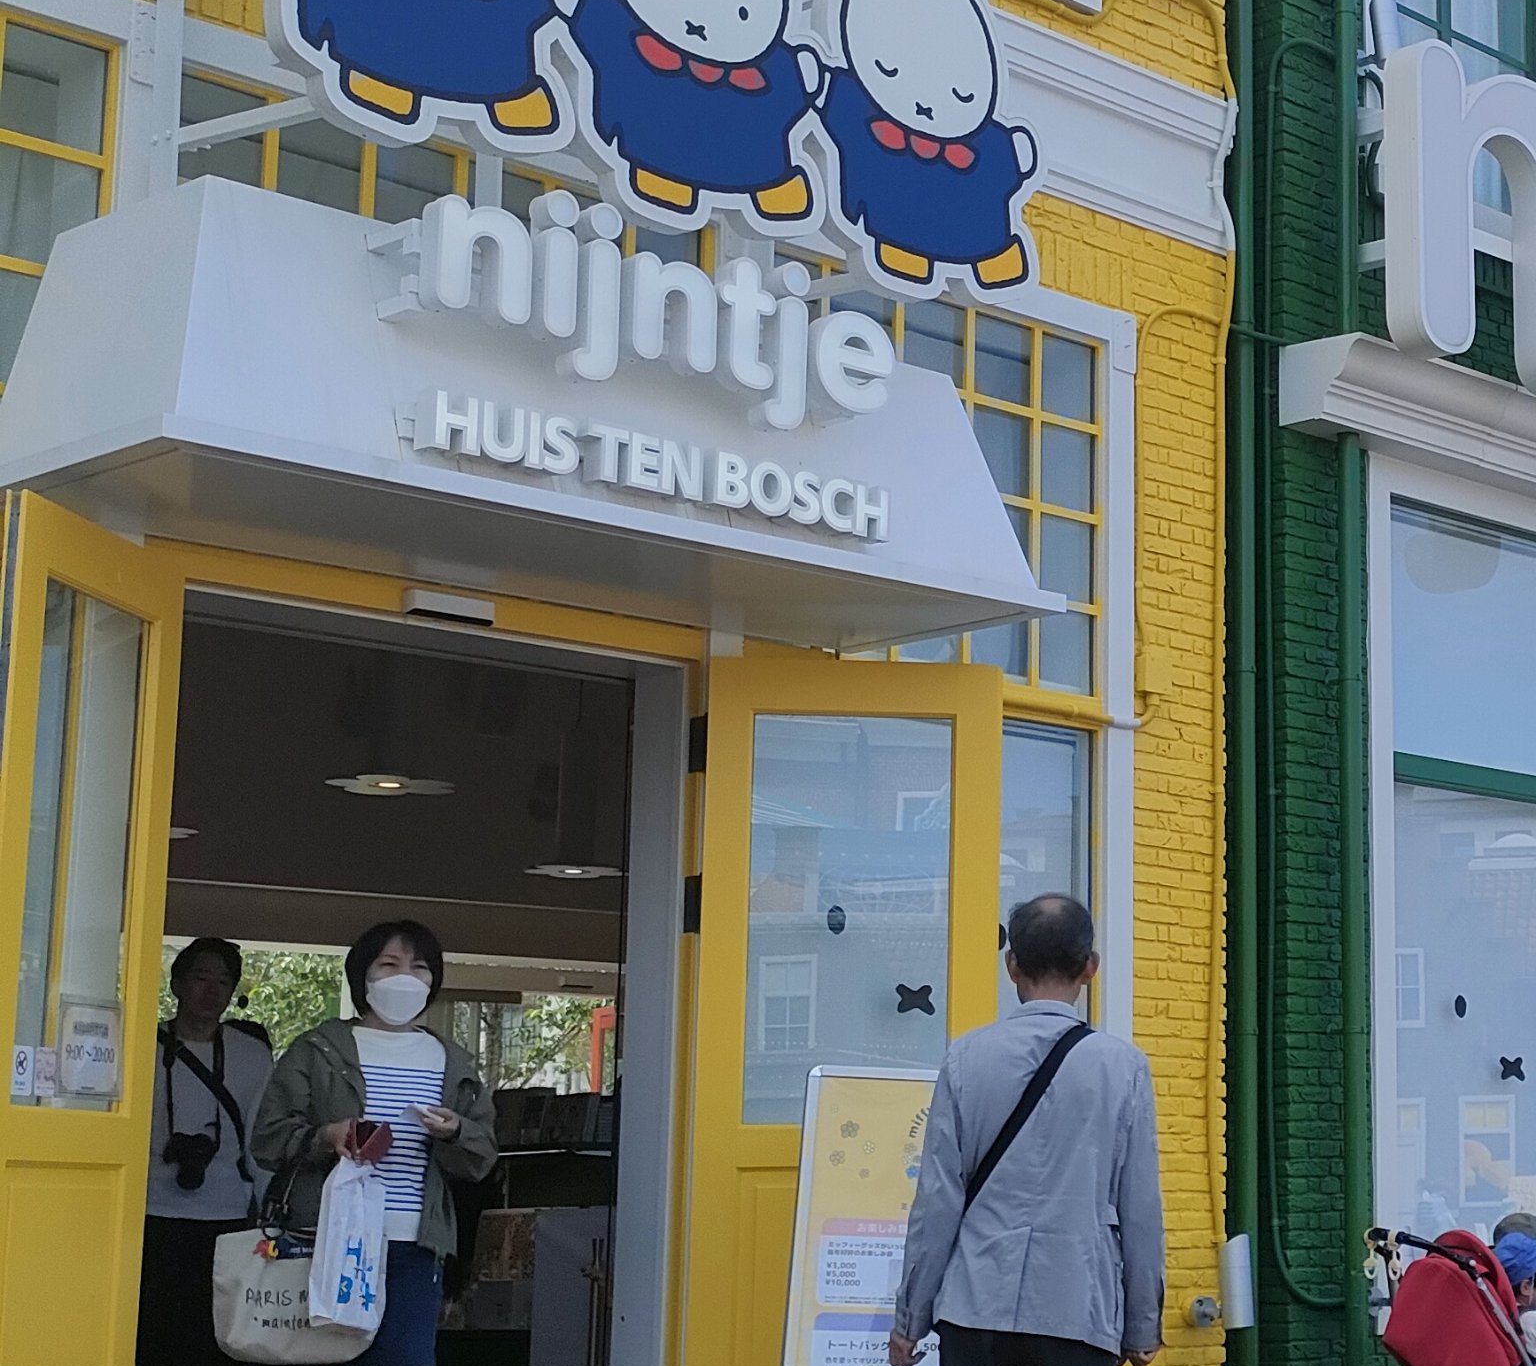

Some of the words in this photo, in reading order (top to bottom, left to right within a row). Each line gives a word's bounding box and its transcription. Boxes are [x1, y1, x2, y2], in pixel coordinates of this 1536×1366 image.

[418, 189, 897, 431] nijntje
[424, 389, 580, 475] HUIS
[582, 420, 703, 503] TEN
[710, 449, 890, 543] BOSCH
[826, 1261, 857, 1270] ¥3,000
[826, 1270, 856, 1278] ¥5,000
[825, 1278, 861, 1287] ¥10,000
[245, 1287, 292, 1307] PARIS
